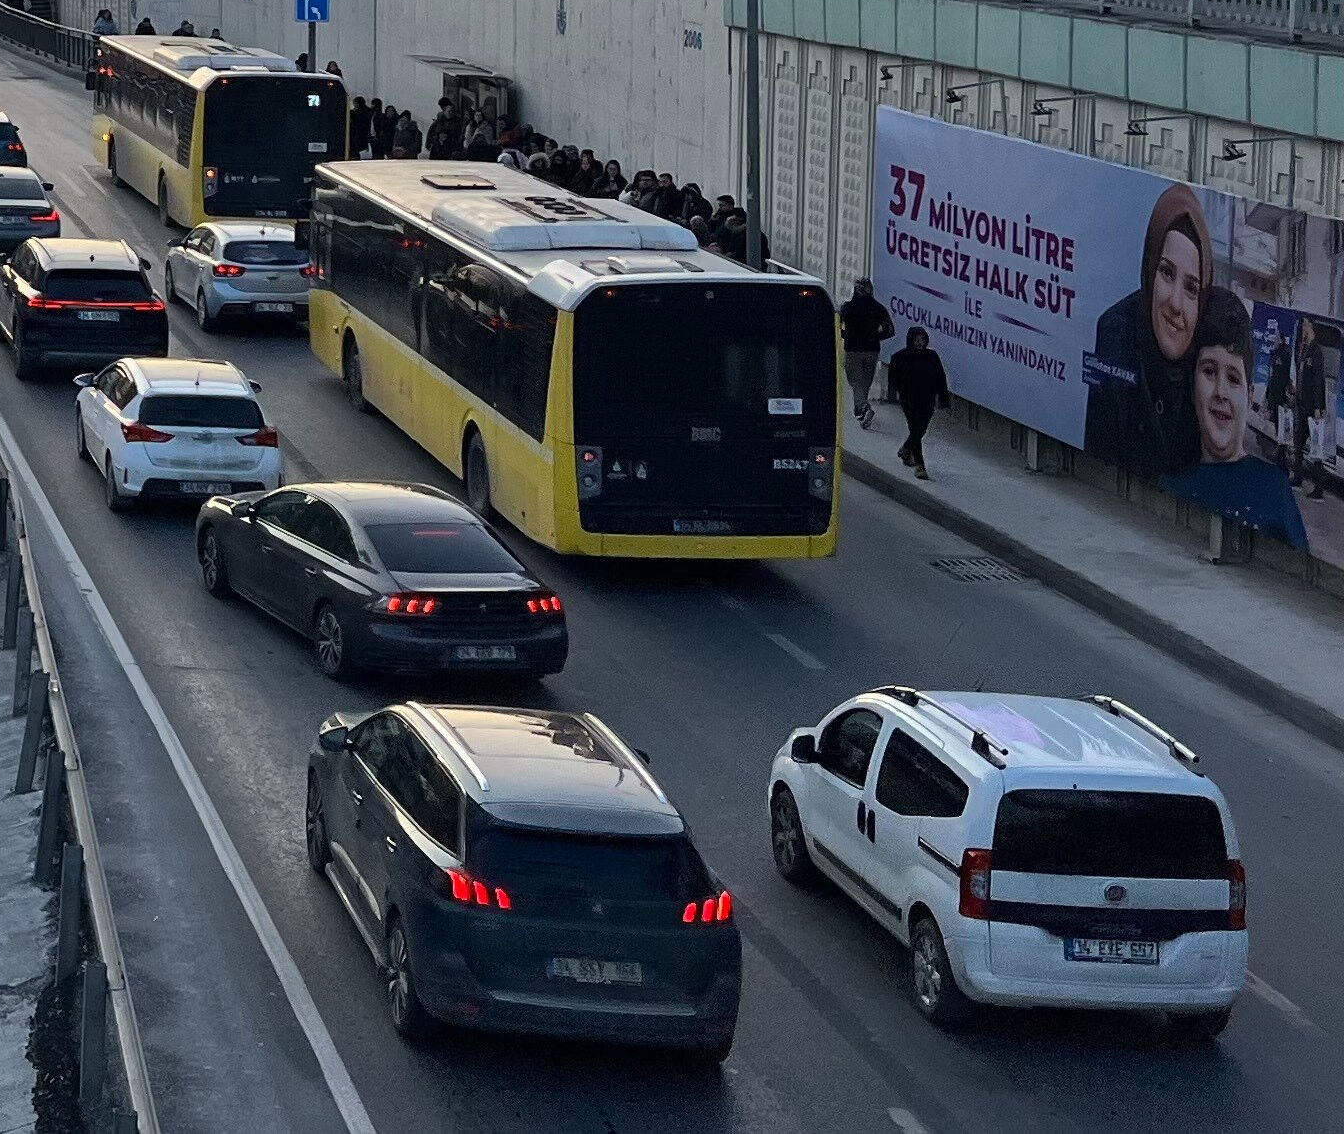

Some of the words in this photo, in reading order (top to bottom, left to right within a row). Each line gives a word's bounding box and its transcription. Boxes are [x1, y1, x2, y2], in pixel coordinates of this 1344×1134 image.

[888, 163, 926, 222] 37
[928, 191, 1007, 251] MİLYON
[1011, 213, 1076, 273] LİTRE
[885, 219, 972, 284] ÜCRETSİZ
[975, 257, 1030, 305] HALK
[1033, 272, 1077, 319] SÜT
[964, 290, 983, 319] İLE
[889, 295, 988, 350] ÇOCUKLARIMIZIN
[989, 333, 1067, 382] YANINDAYIZ
